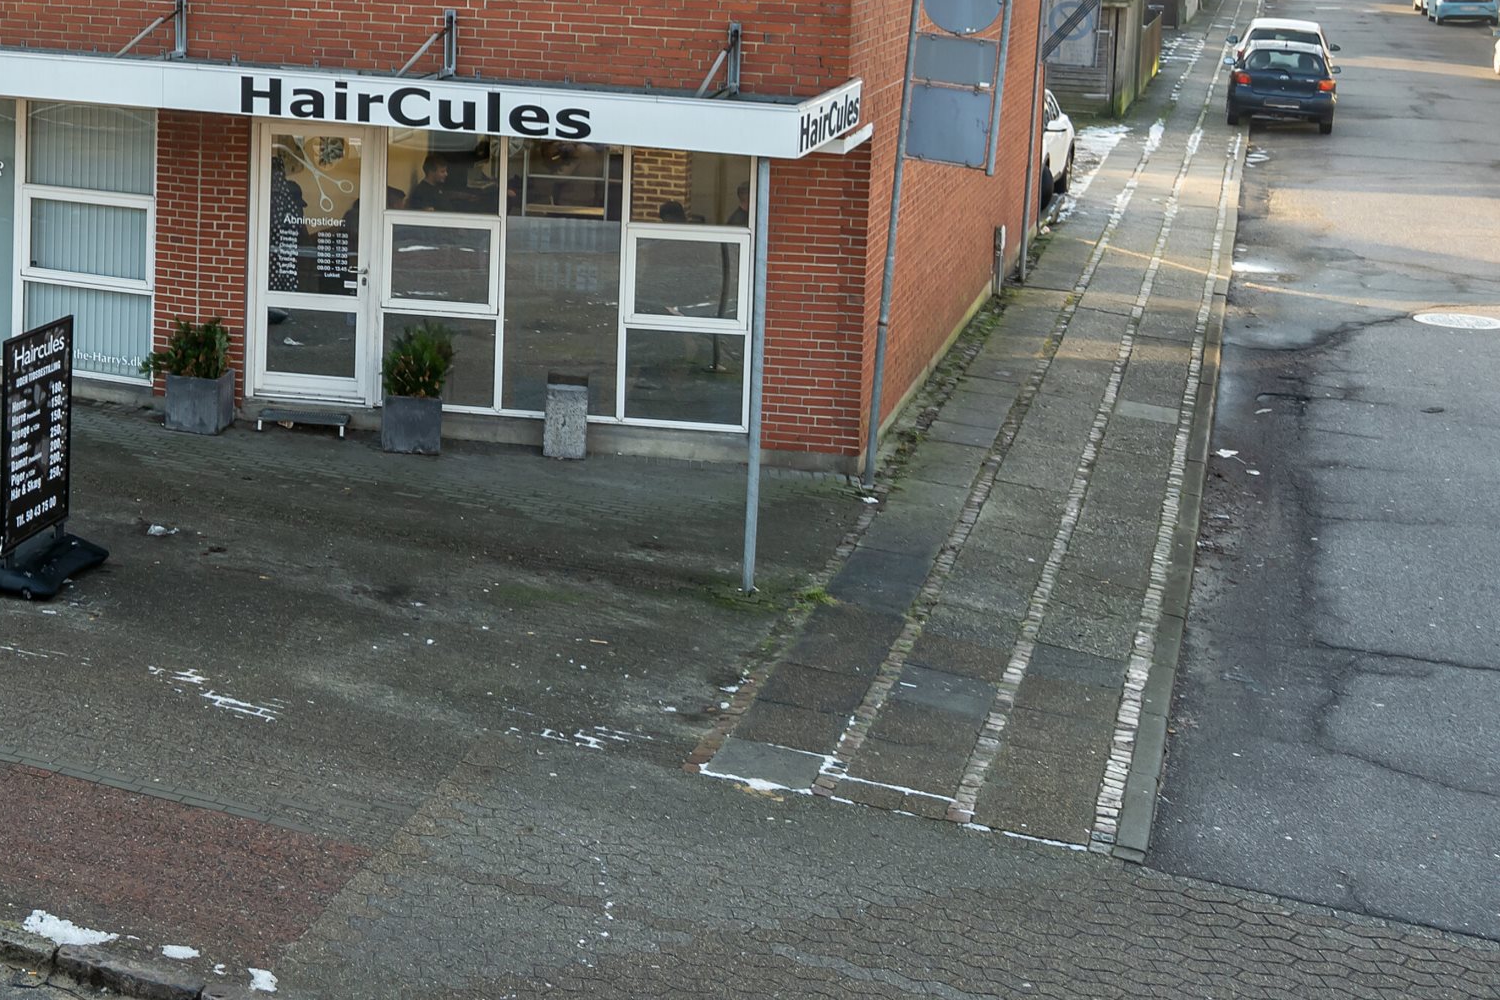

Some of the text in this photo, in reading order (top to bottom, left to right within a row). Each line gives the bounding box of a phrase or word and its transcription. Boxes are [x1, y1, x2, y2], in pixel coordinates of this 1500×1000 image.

[241, 76, 591, 139] HairCules
[800, 94, 859, 152] HairCules
[284, 213, 346, 228] Åbningstider:
[14, 334, 65, 370] Haircules
[73, 349, 143, 367] the-HarryS.dk
[11, 471, 25, 486] Piger
[22, 483, 26, 495] &
[34, 504, 41, 517] 43
[42, 500, 48, 513] 75
